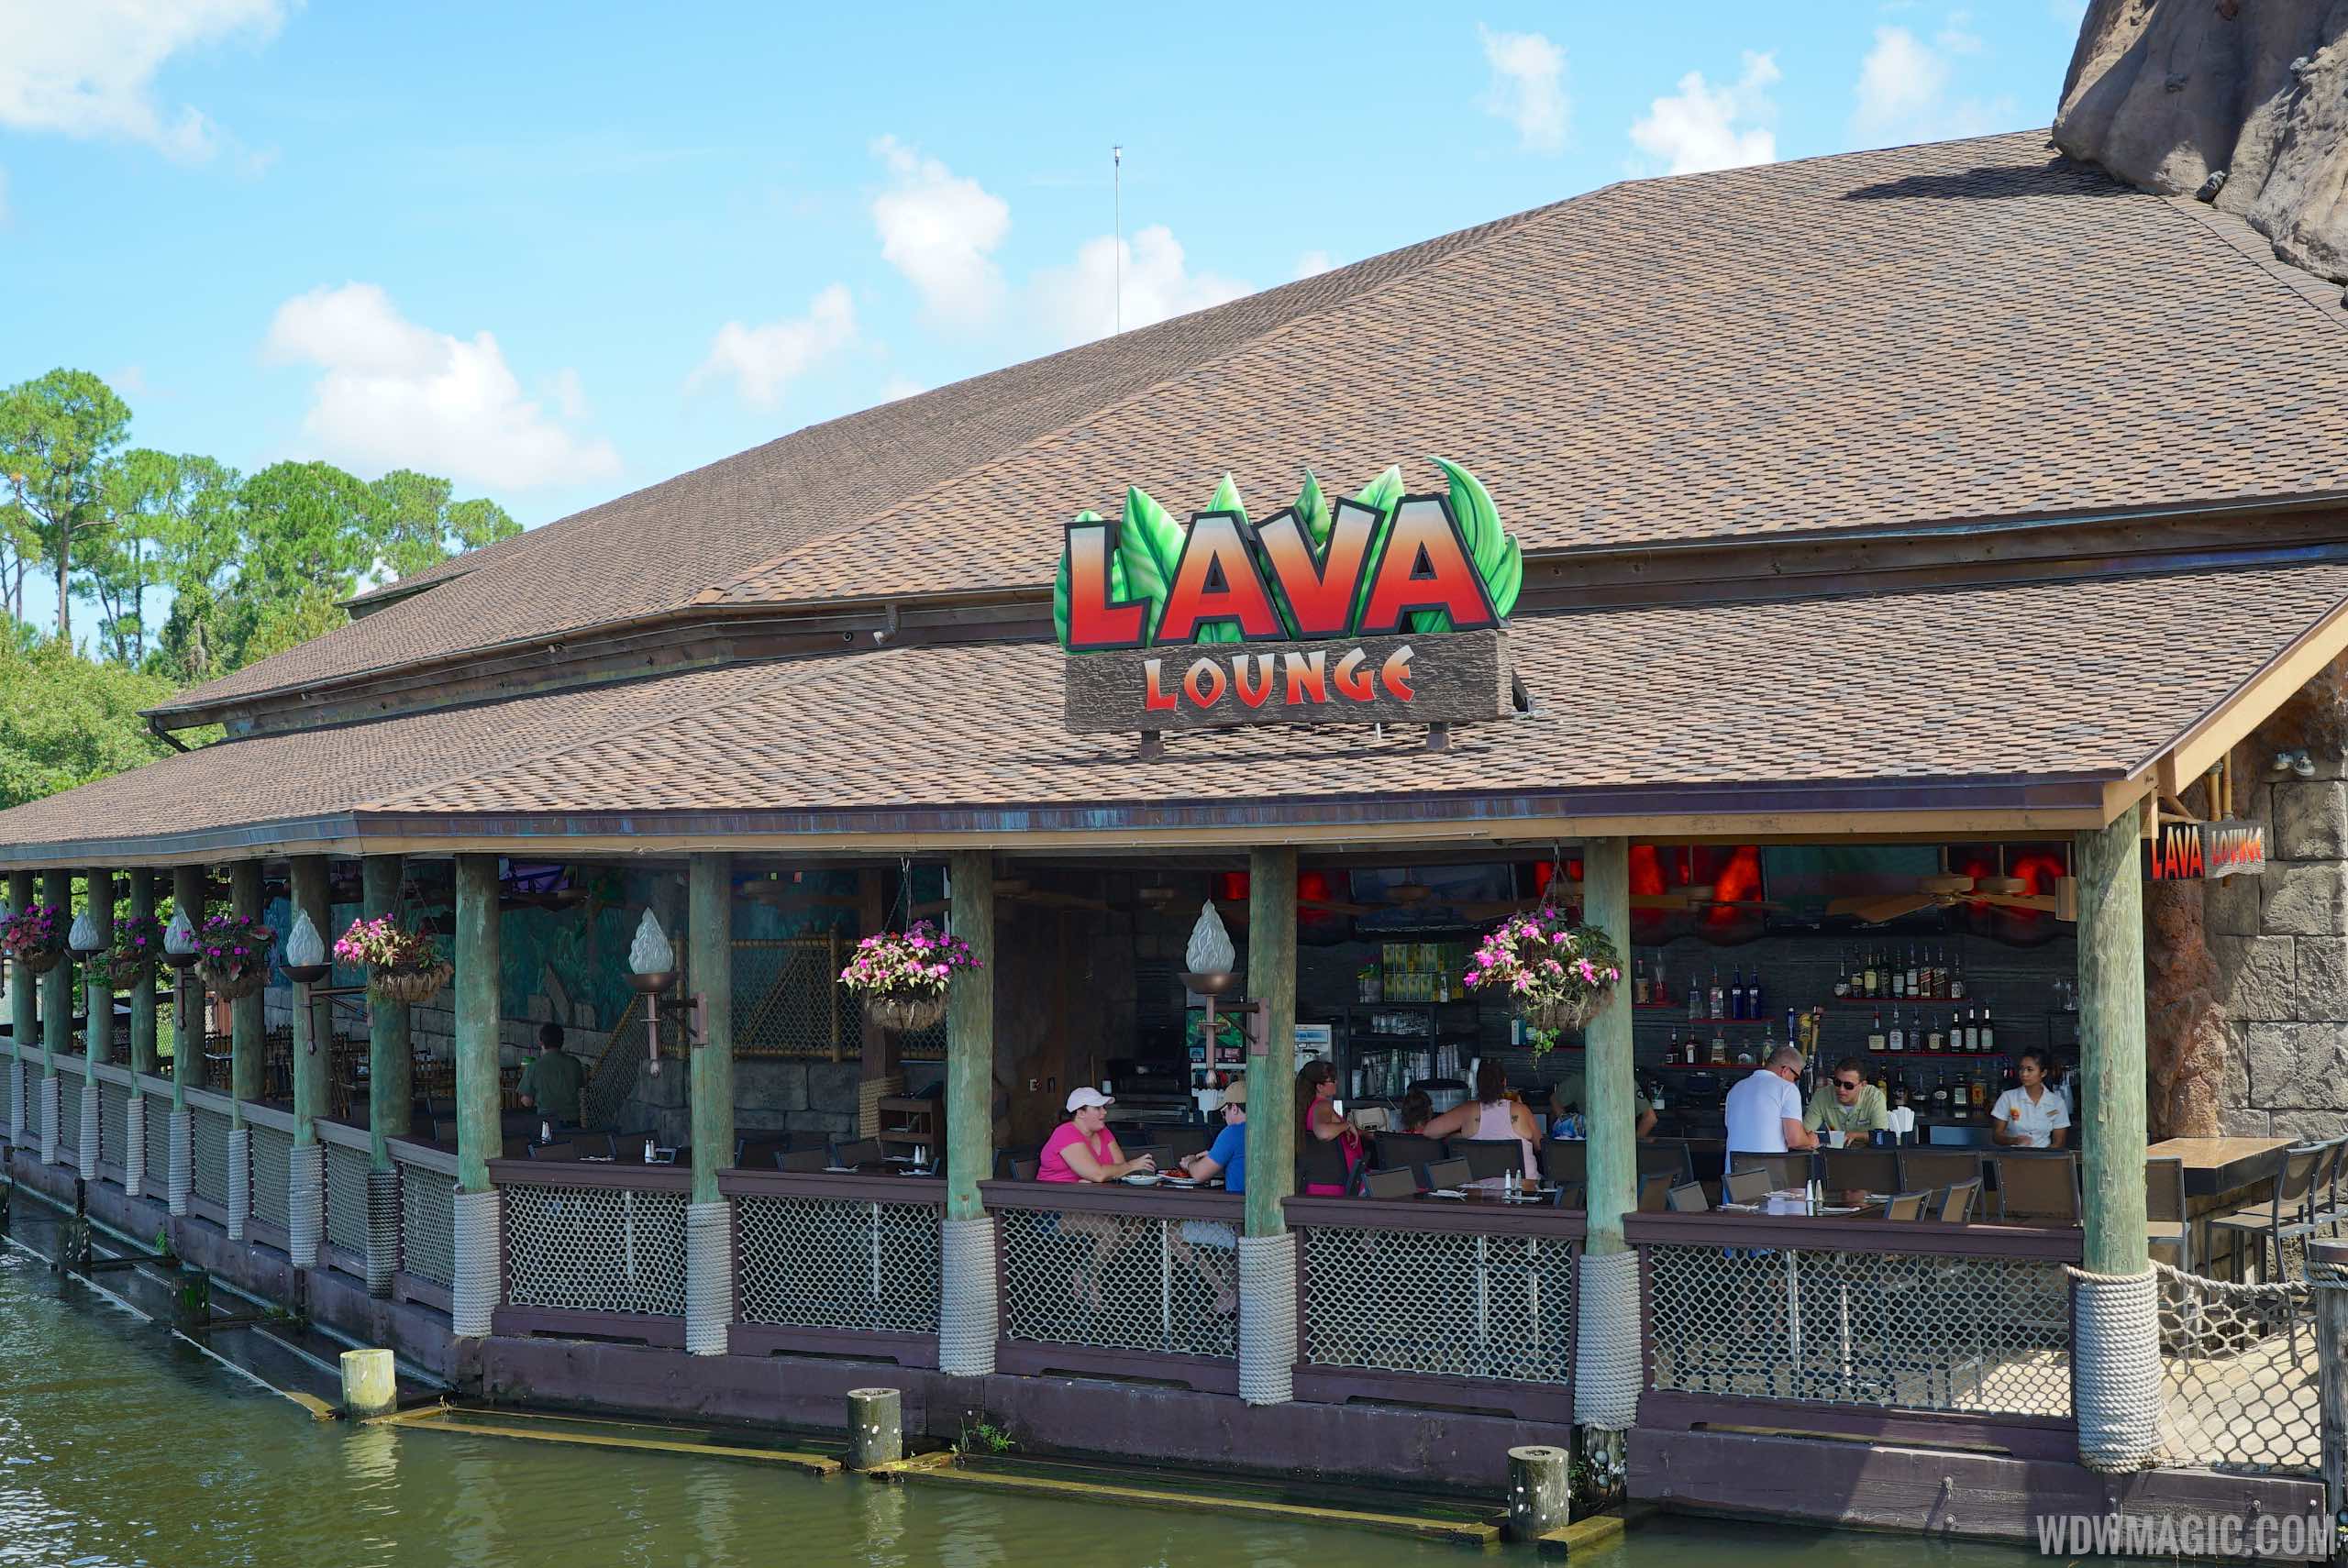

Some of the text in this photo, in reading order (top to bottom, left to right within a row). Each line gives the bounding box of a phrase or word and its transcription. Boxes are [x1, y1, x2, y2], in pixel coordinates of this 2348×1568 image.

[1065, 494, 1500, 650] LAVA
[1144, 645, 1415, 712] LOUNGE
[2152, 825, 2204, 879] LAVA
